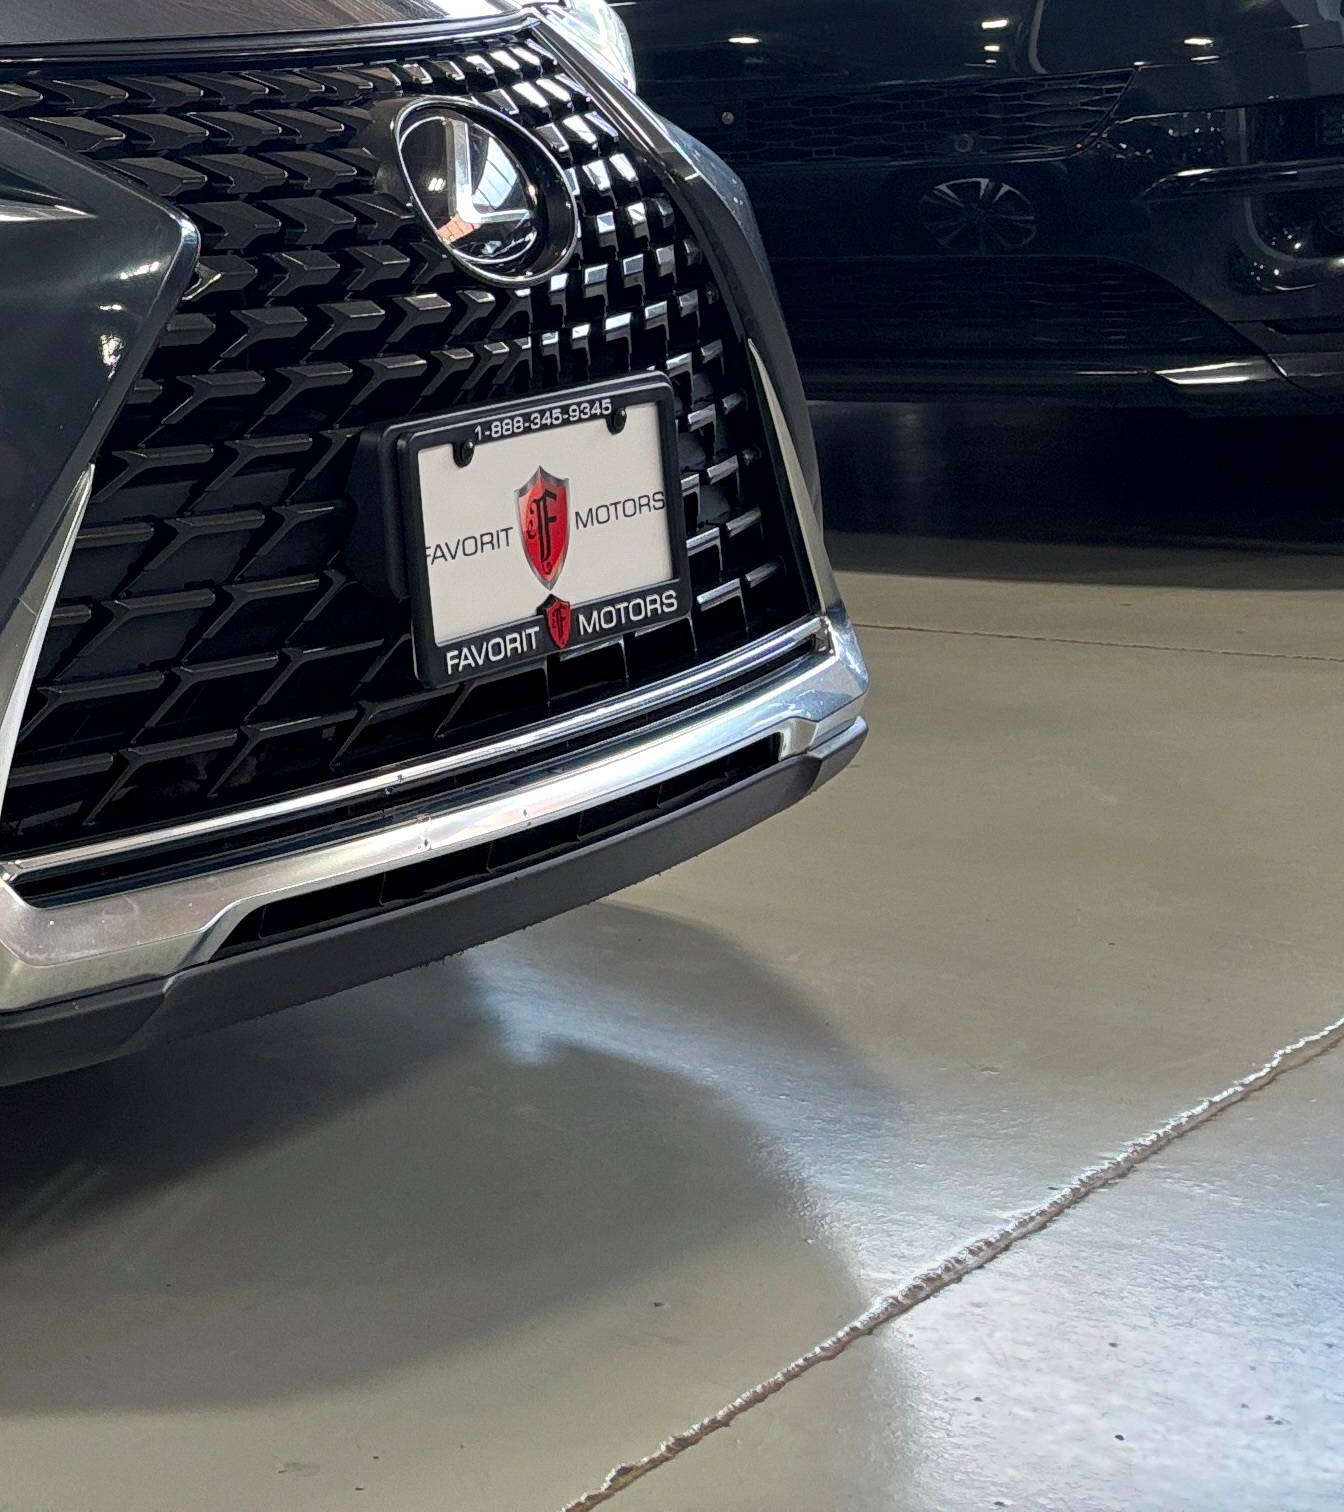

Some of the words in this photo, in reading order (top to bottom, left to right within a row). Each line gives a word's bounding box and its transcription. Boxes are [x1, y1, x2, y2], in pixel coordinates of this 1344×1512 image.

[474, 398, 613, 442] 1-888-345-9345
[574, 490, 666, 530] MOTORS
[446, 626, 541, 675] FAVORIT
[577, 590, 678, 635] MOTORS
